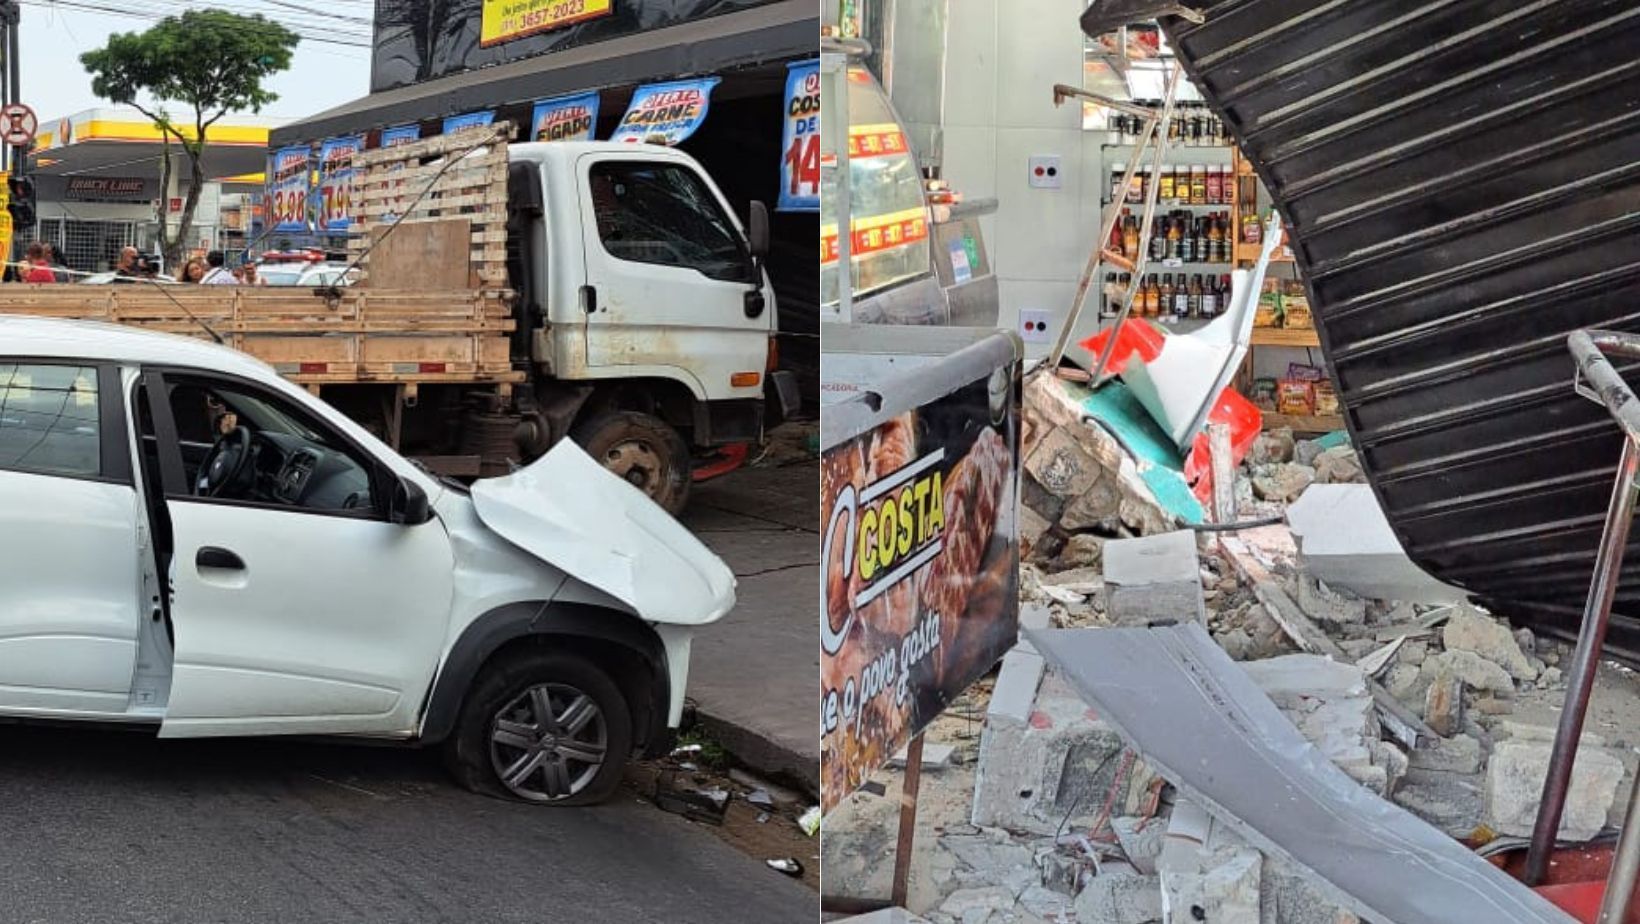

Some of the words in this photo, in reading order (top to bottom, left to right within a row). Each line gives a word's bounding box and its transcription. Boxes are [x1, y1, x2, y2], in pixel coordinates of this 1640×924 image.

[624, 102, 698, 125] CARNE
[796, 116, 815, 135] DE
[858, 470, 945, 579] COSTA
[844, 678, 854, 718] o
[856, 647, 896, 740] povo
[896, 608, 940, 707] gosta
